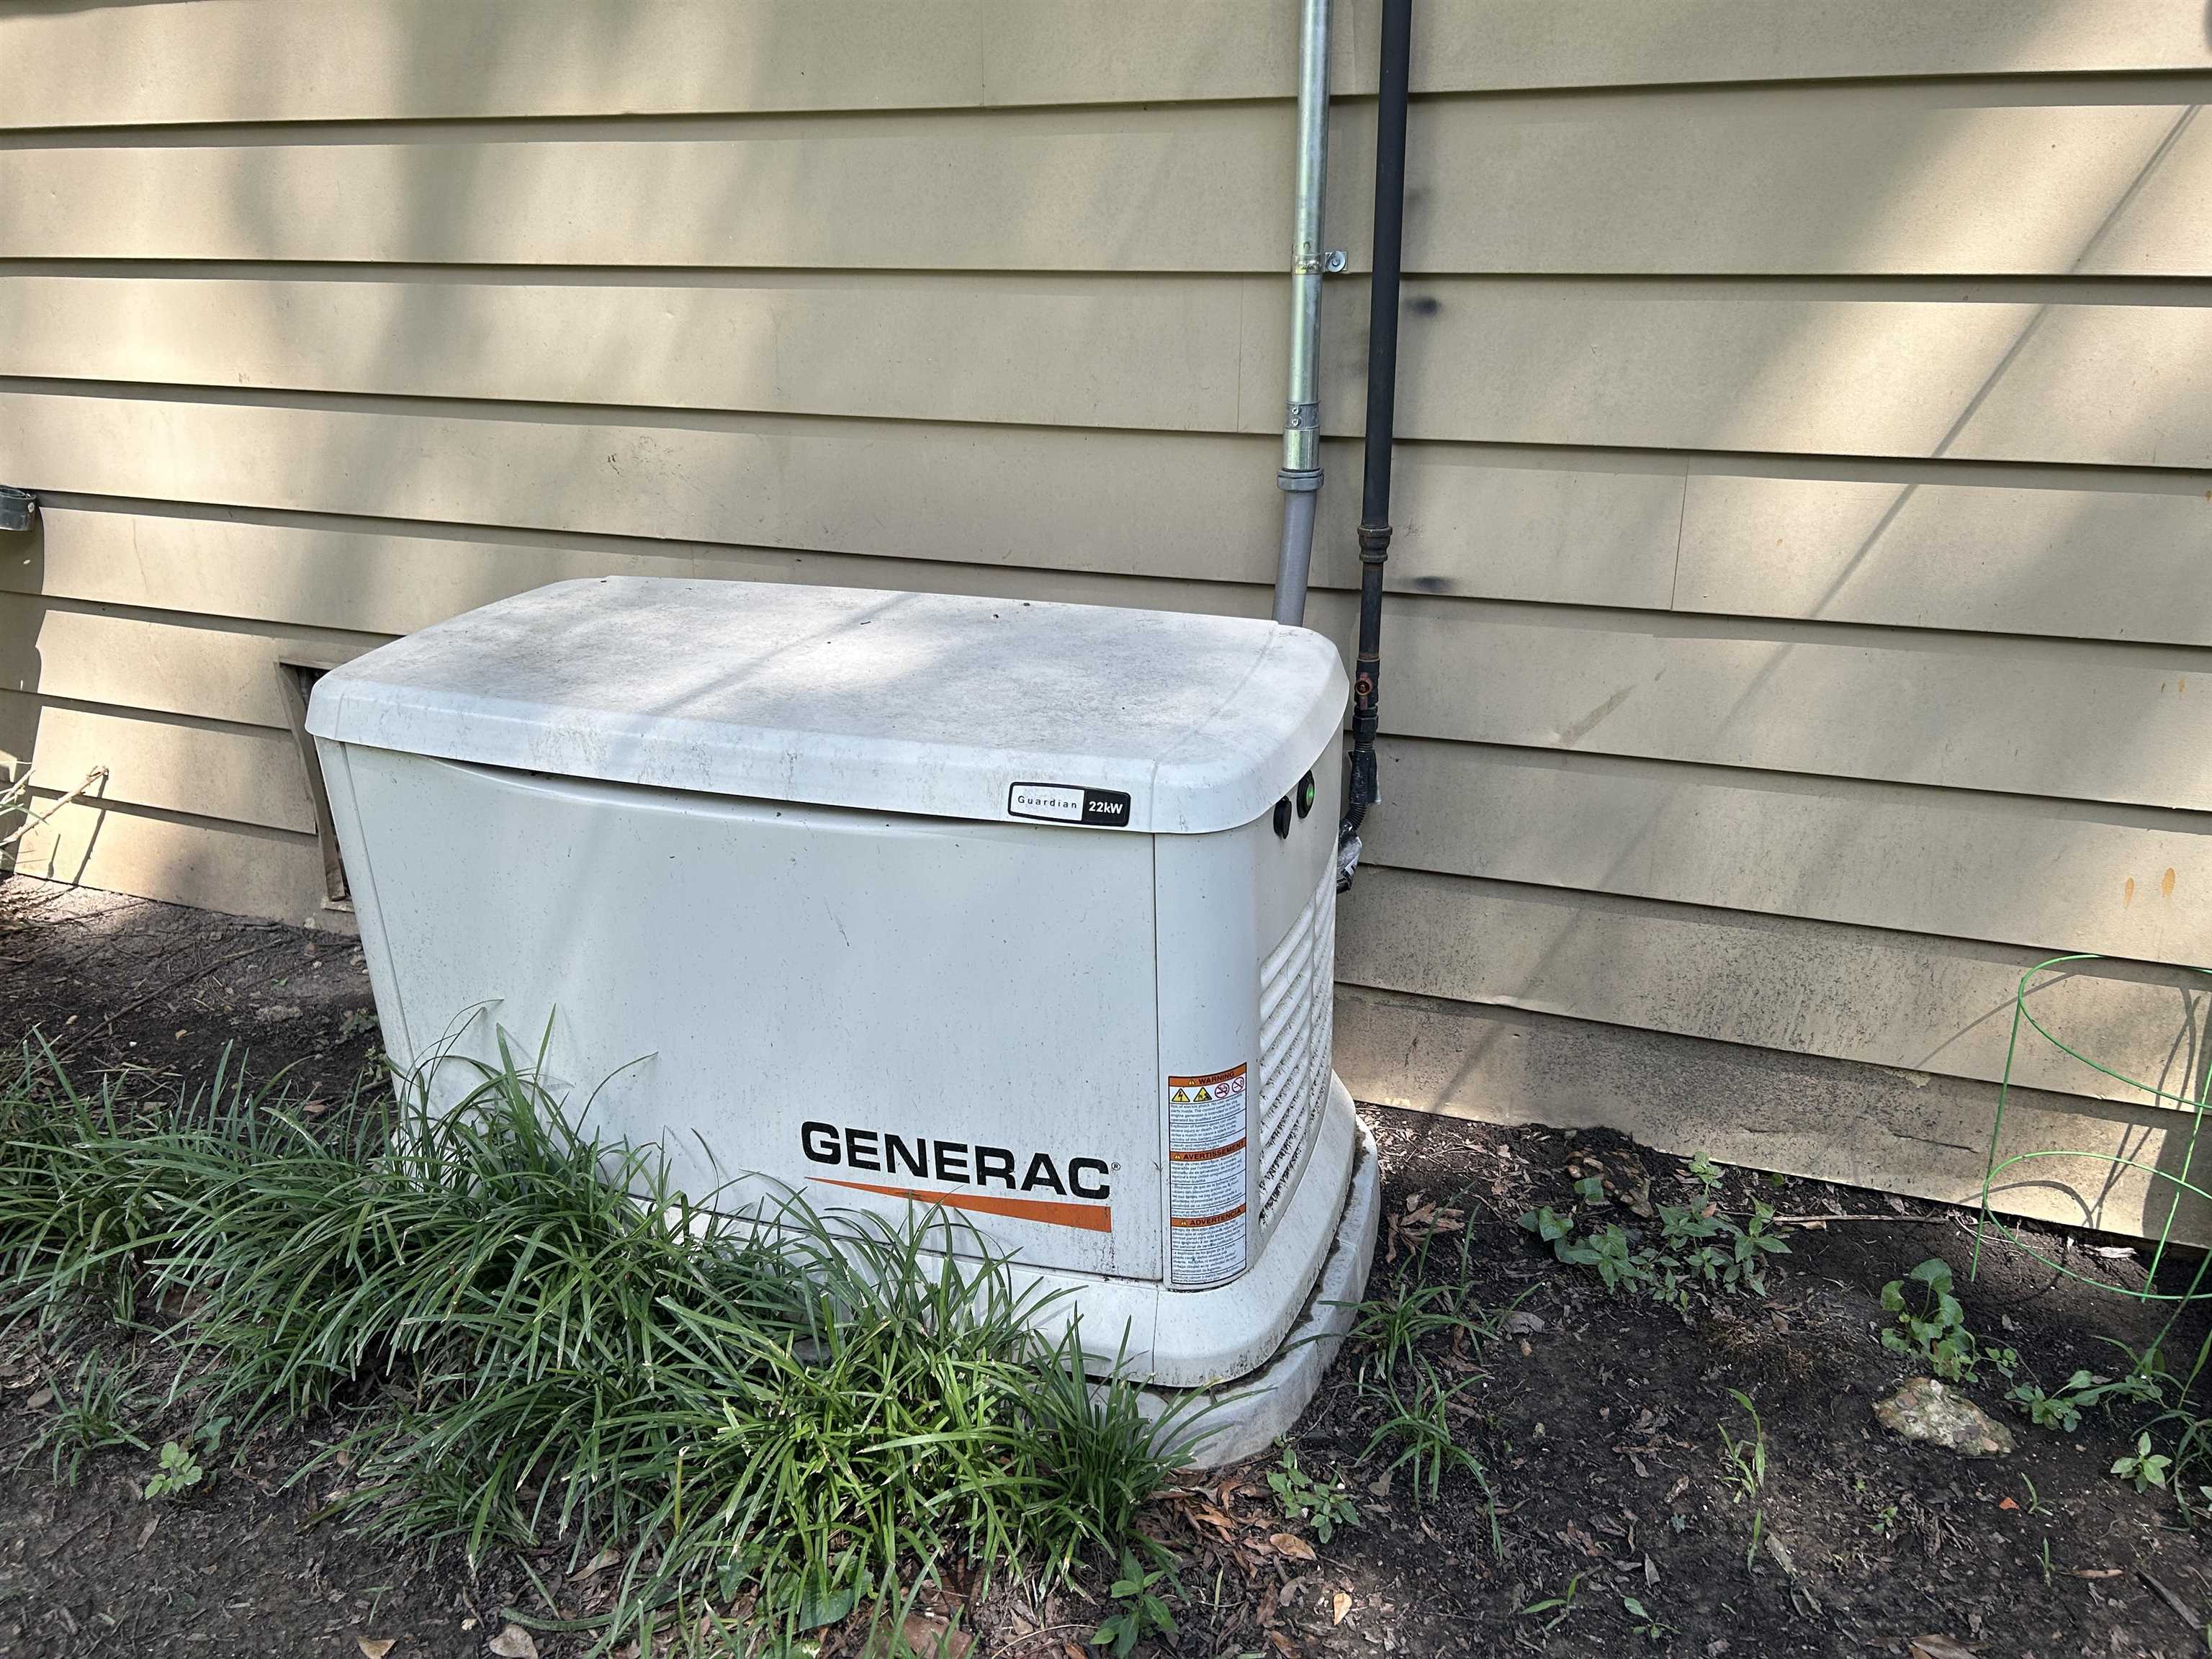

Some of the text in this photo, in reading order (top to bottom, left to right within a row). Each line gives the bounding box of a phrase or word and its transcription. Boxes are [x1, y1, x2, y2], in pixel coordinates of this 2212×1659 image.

[1017, 796, 1123, 814] Guardian 22kW
[1198, 1071, 1234, 1084] WARNING
[1183, 1141, 1244, 1160] AVERTISSEMENT
[1190, 1208, 1241, 1226] ADVERTENCIA
